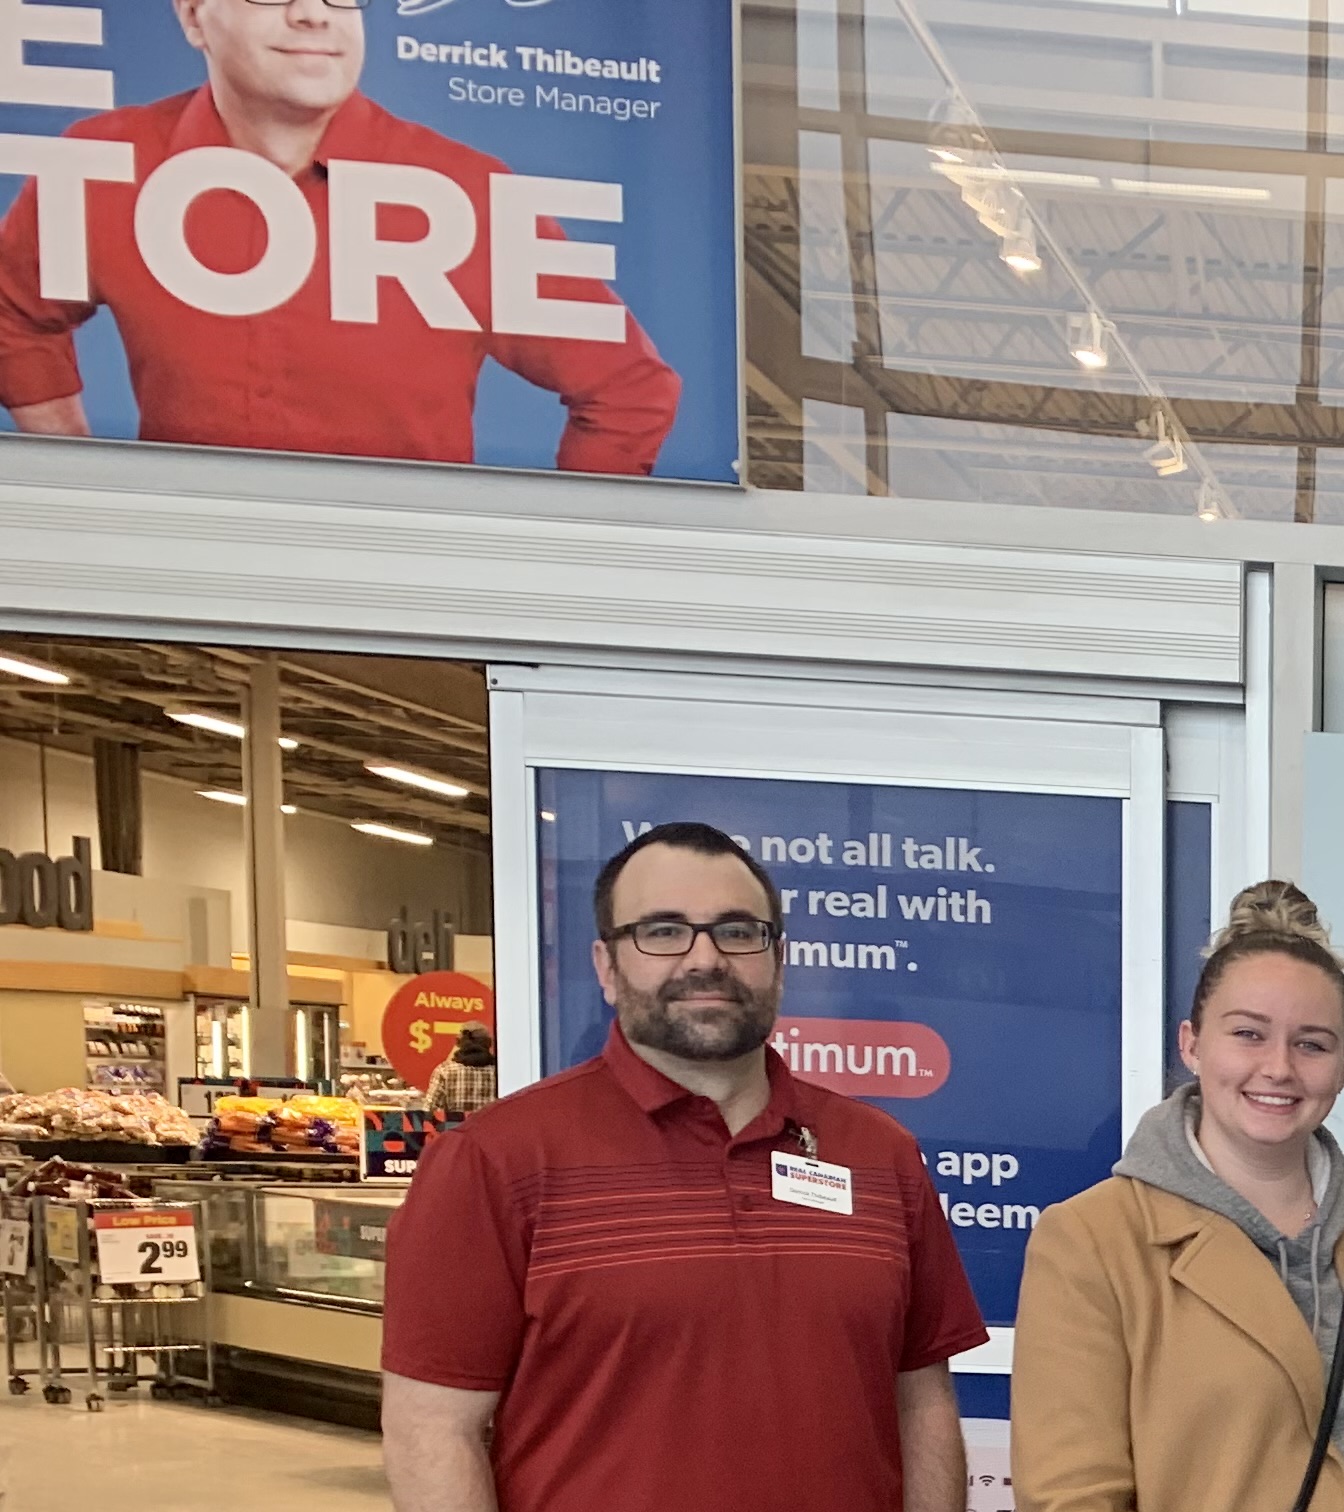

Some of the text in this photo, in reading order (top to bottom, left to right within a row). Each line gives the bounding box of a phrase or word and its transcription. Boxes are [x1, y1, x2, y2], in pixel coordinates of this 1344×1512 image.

[396, 35, 661, 83] Derrick Thibeault
[448, 77, 662, 121] Store Manager
[761, 833, 834, 864] not
[842, 834, 892, 867] all
[903, 837, 996, 873] talk.
[809, 885, 992, 924] real with
[415, 990, 484, 1013] Always
[790, 1172, 846, 1190] SUPERSTORE
[937, 1151, 1019, 1186] app
[112, 1214, 177, 1226] Low Price
